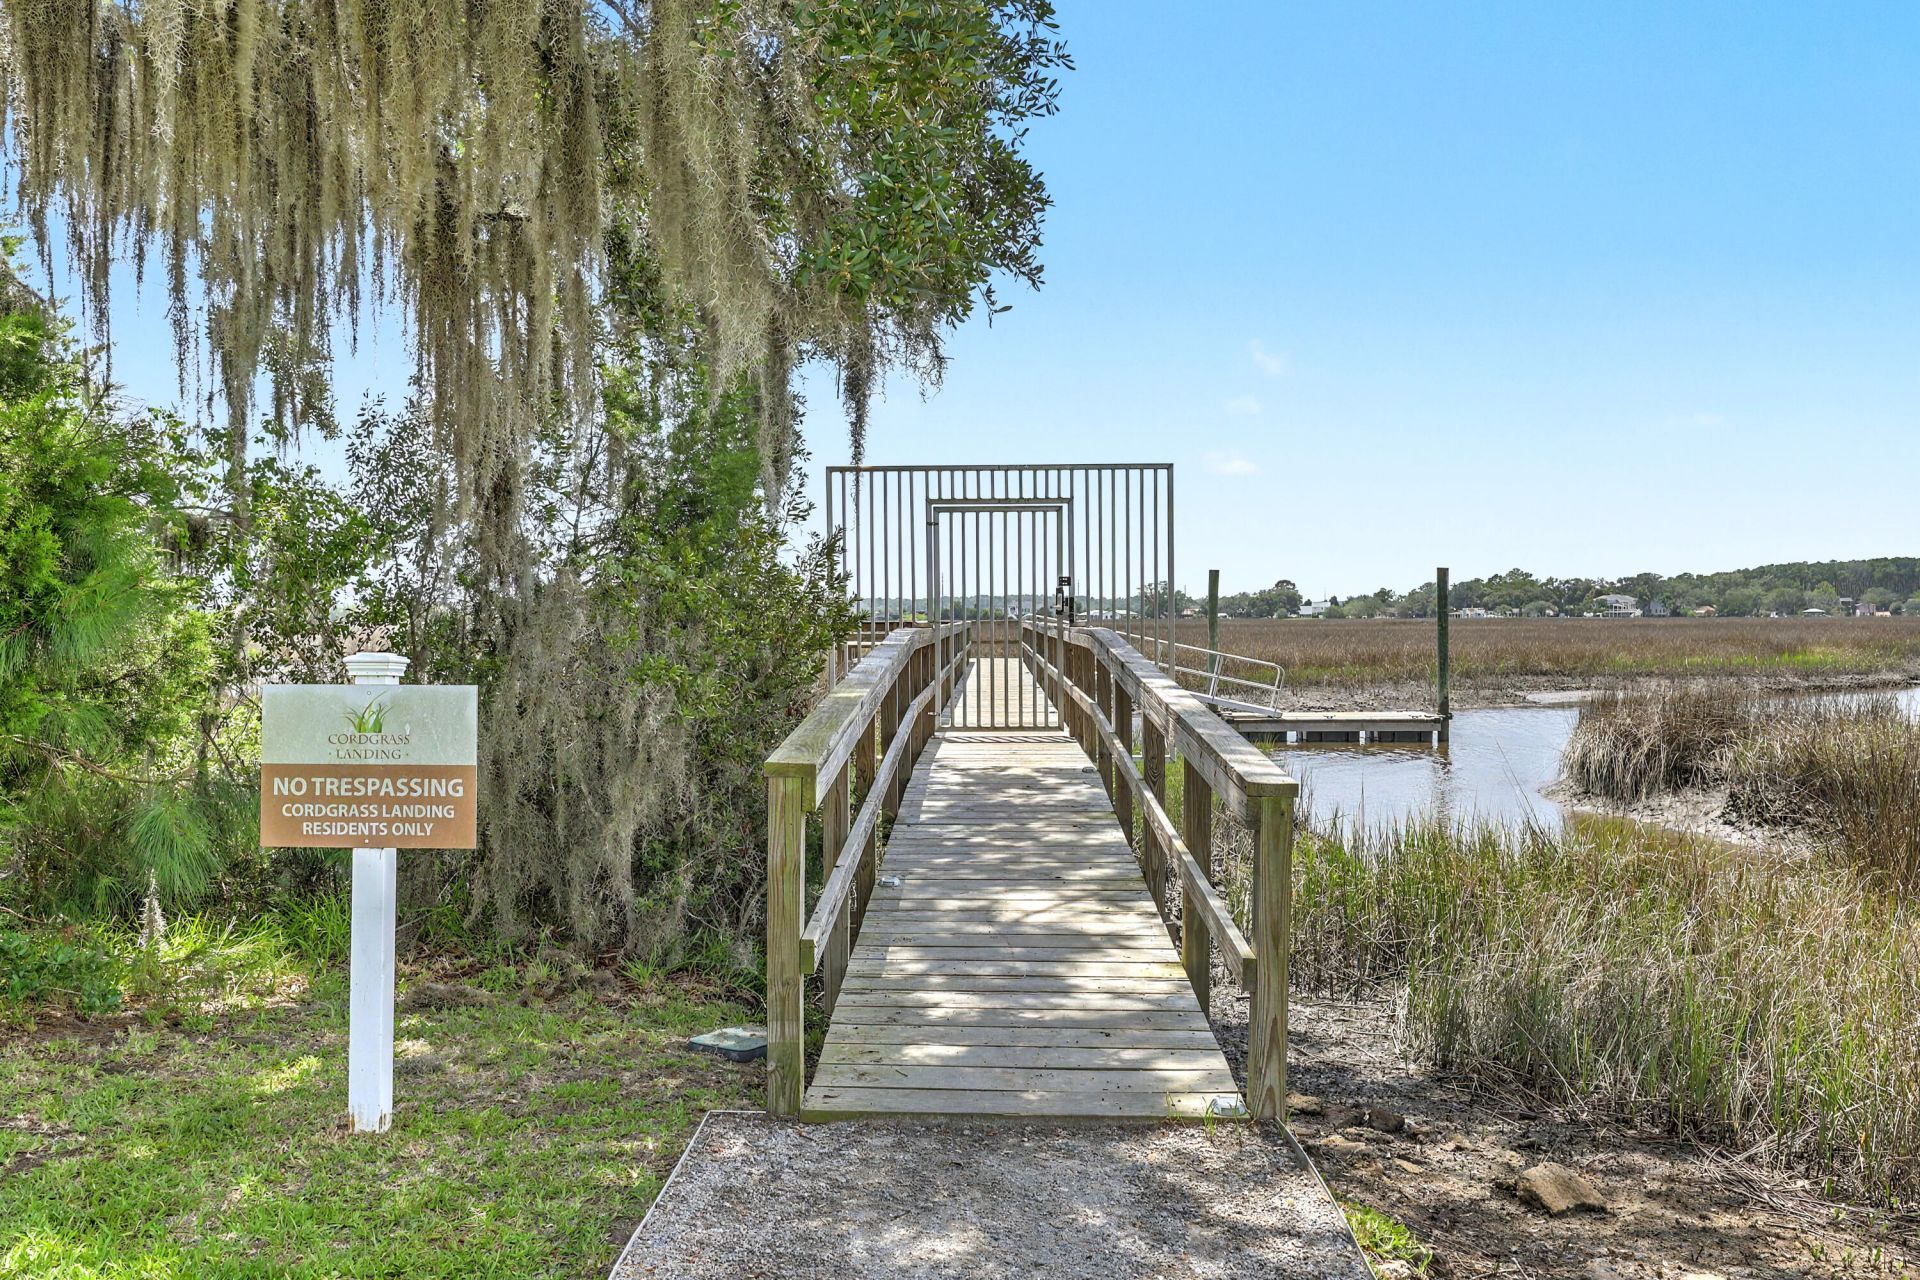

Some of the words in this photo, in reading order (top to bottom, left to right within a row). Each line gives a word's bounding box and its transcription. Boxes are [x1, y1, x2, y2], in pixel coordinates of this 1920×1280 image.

[328, 733, 410, 745] CORDGRASS
[336, 749, 401, 760] LANDING
[273, 777, 308, 796] NO
[311, 777, 464, 798] TRESPASSING
[281, 803, 378, 818] CORDGRASS
[382, 804, 455, 819] LANDING
[302, 821, 388, 836] RESIDENTS
[391, 822, 434, 836] ONLY
